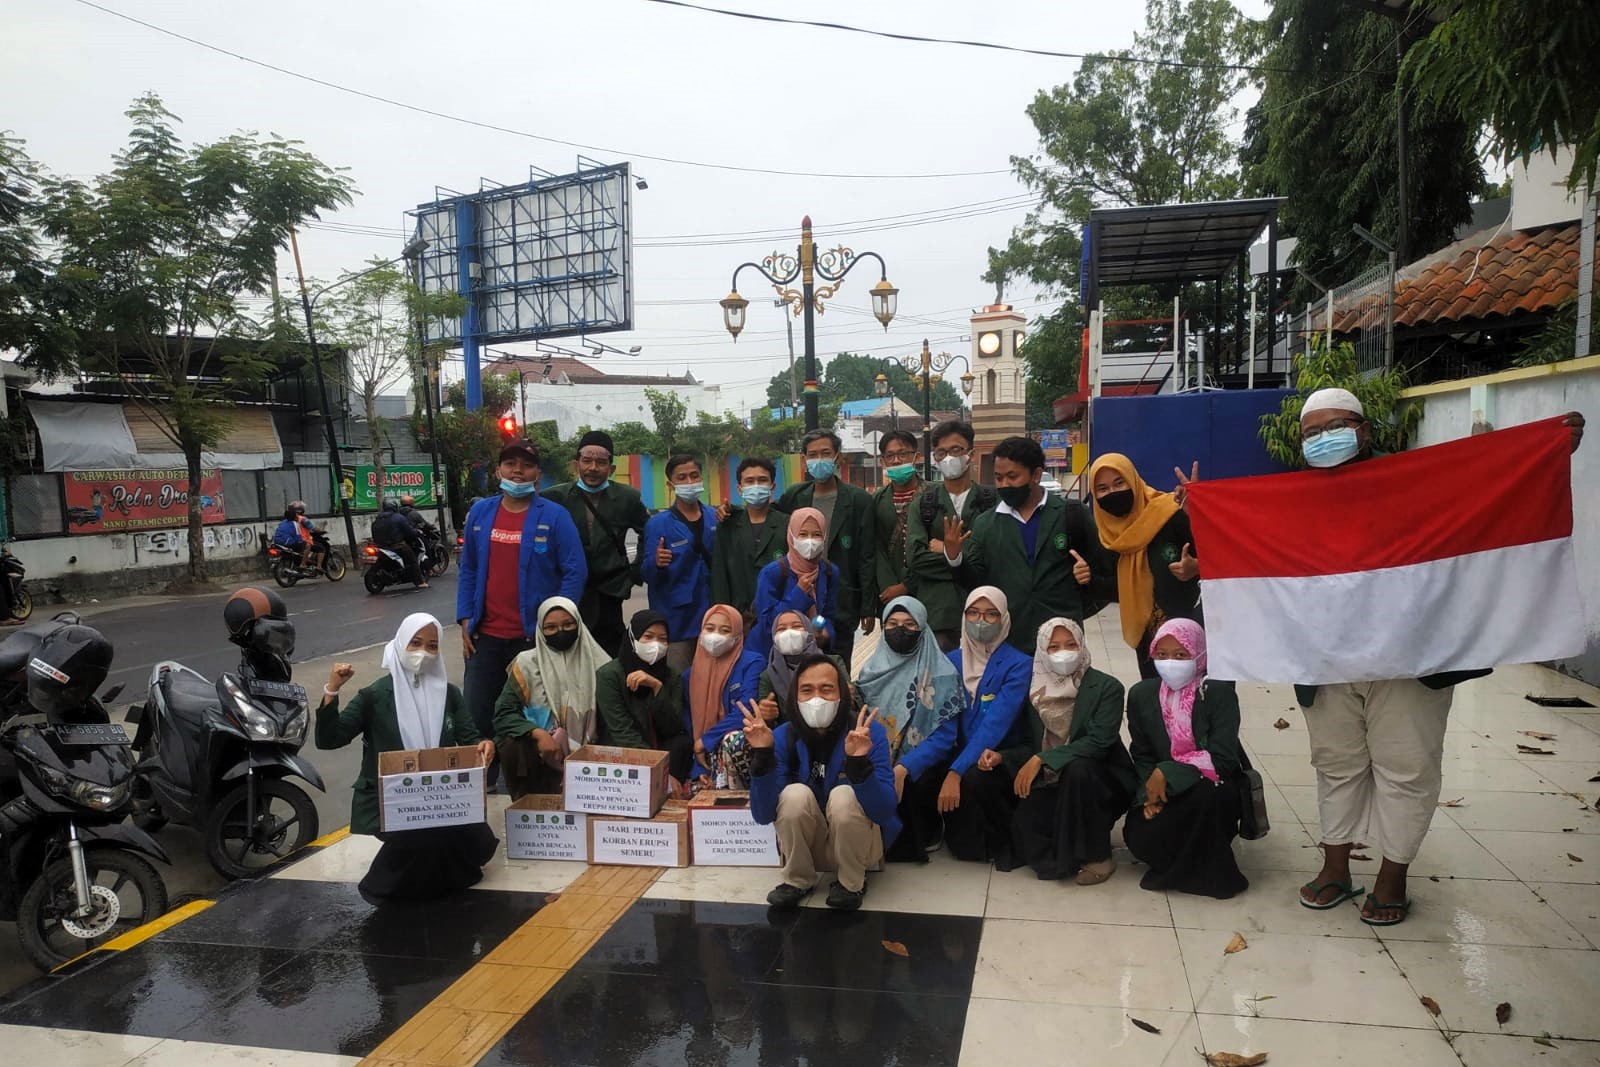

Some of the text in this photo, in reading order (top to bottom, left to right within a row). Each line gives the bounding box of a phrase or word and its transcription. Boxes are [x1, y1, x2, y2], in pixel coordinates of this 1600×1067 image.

[73, 471, 125, 481] CARWASH
[139, 470, 164, 480] AUTO
[368, 472, 390, 486] RL
[391, 472, 400, 486] N
[401, 472, 424, 486] DRO
[109, 484, 142, 515] Rel
[144, 494, 152, 505] n
[128, 518, 161, 527] CERAMIC
[427, 783, 473, 792] DONASINYA
[397, 802, 471, 813] KORBAN BENCANA
